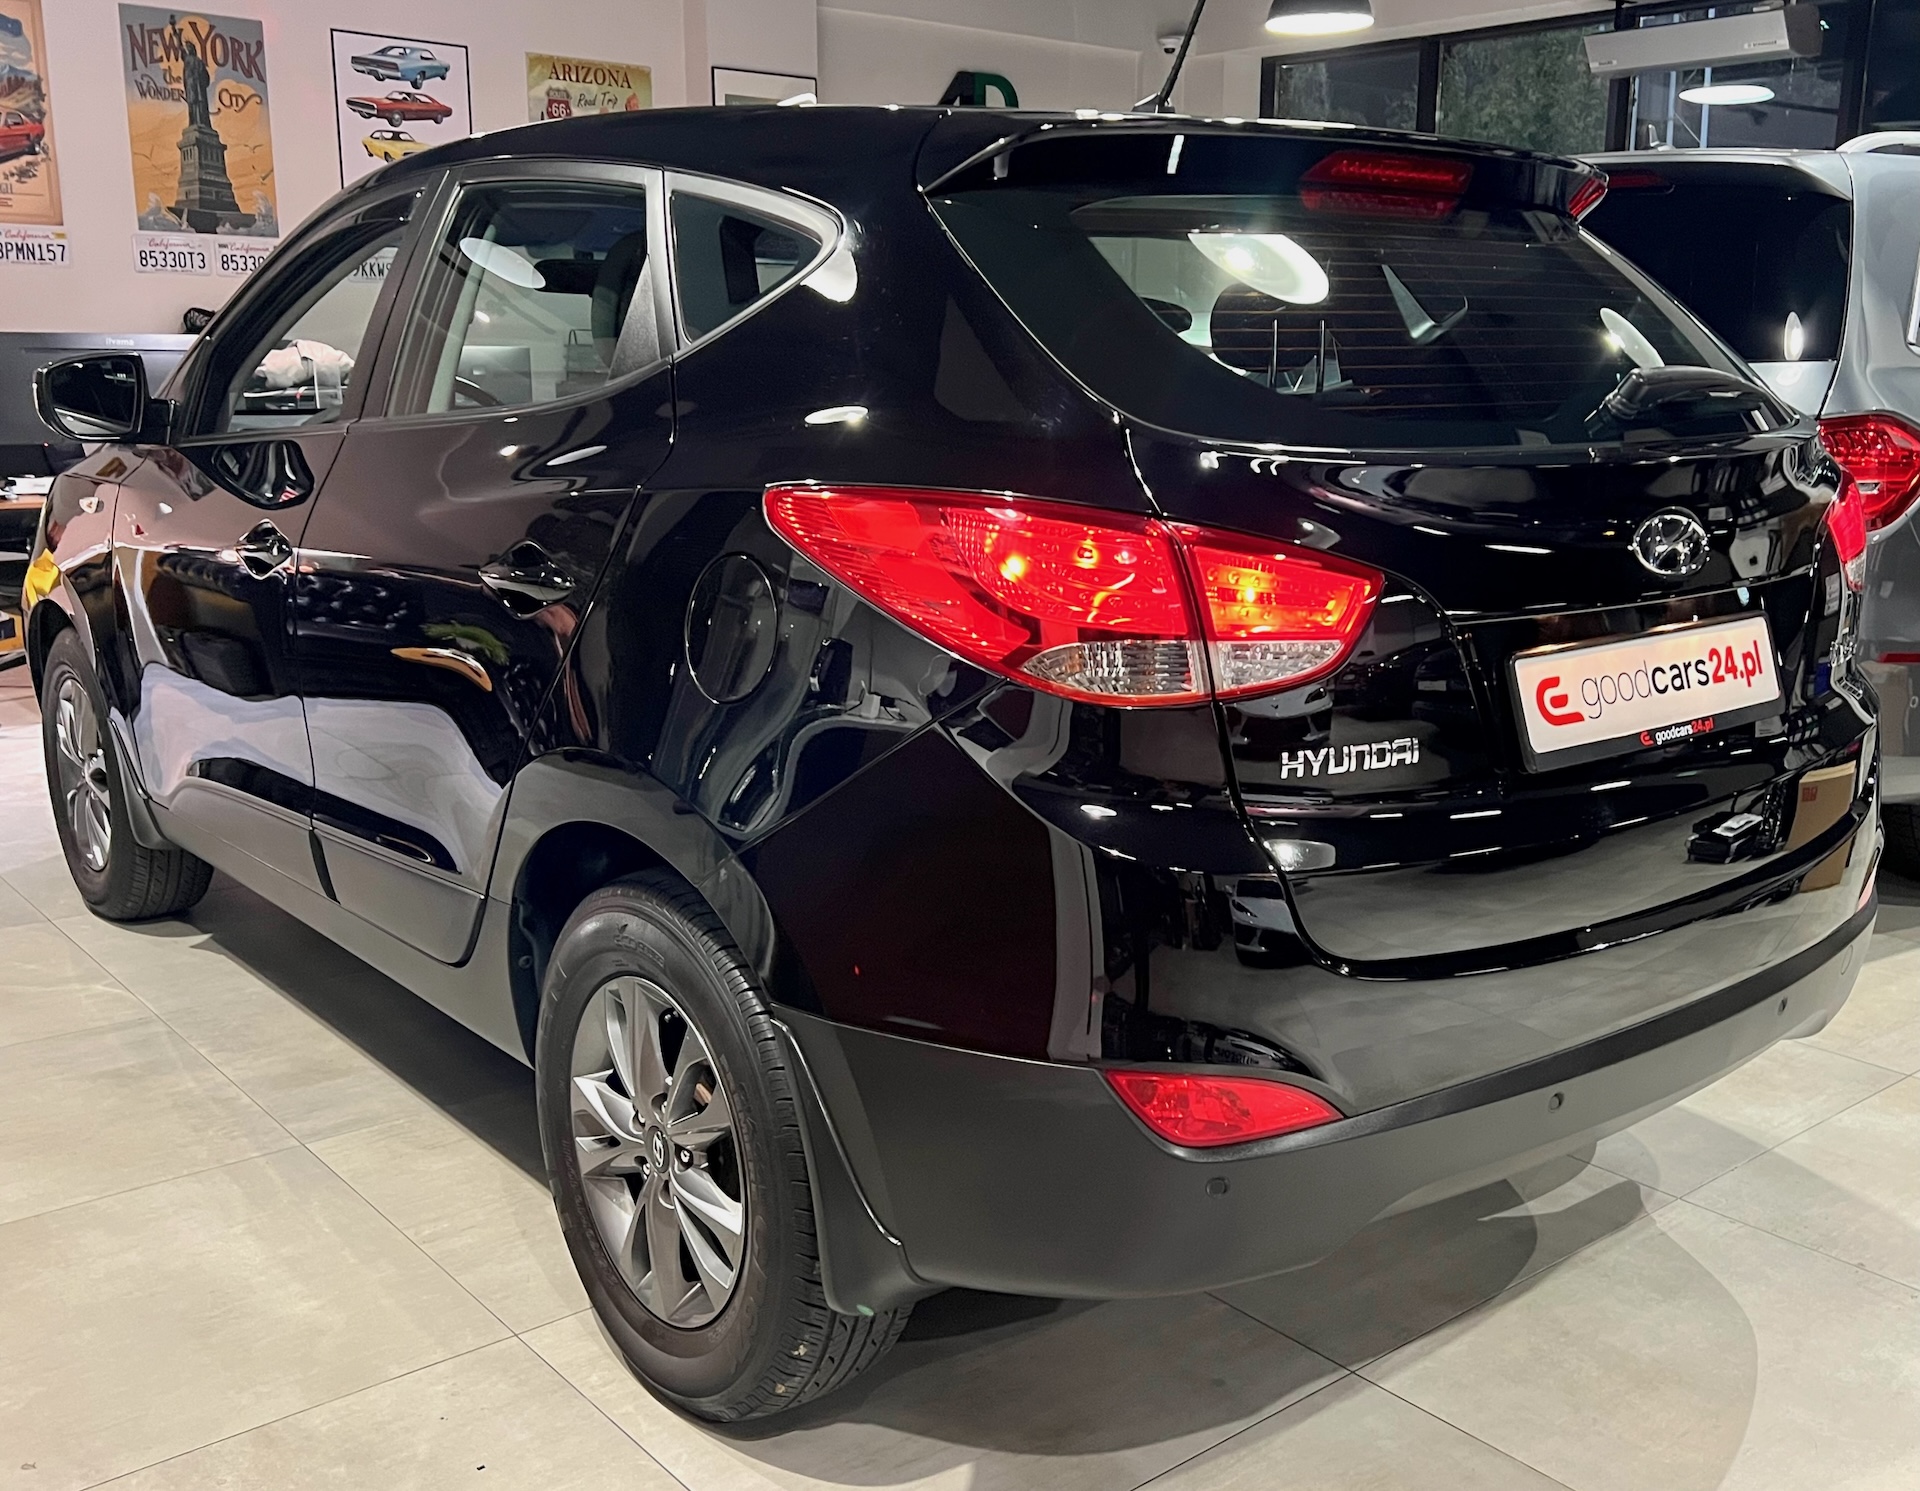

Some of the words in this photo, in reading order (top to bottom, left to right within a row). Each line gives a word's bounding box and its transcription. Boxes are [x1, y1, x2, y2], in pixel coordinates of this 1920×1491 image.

[126, 23, 184, 71] NEW
[188, 21, 266, 83] YORK
[134, 73, 187, 102] WONDER
[162, 65, 182, 85] the
[548, 61, 632, 89] ARIZONA
[551, 102, 567, 117] 66
[577, 93, 598, 107] Road
[139, 250, 206, 269] 85330T3
[1582, 640, 1763, 719] goodcars24.pl
[1655, 717, 1715, 746] goodcars24.pl
[1280, 737, 1420, 780] HYUNDAI
